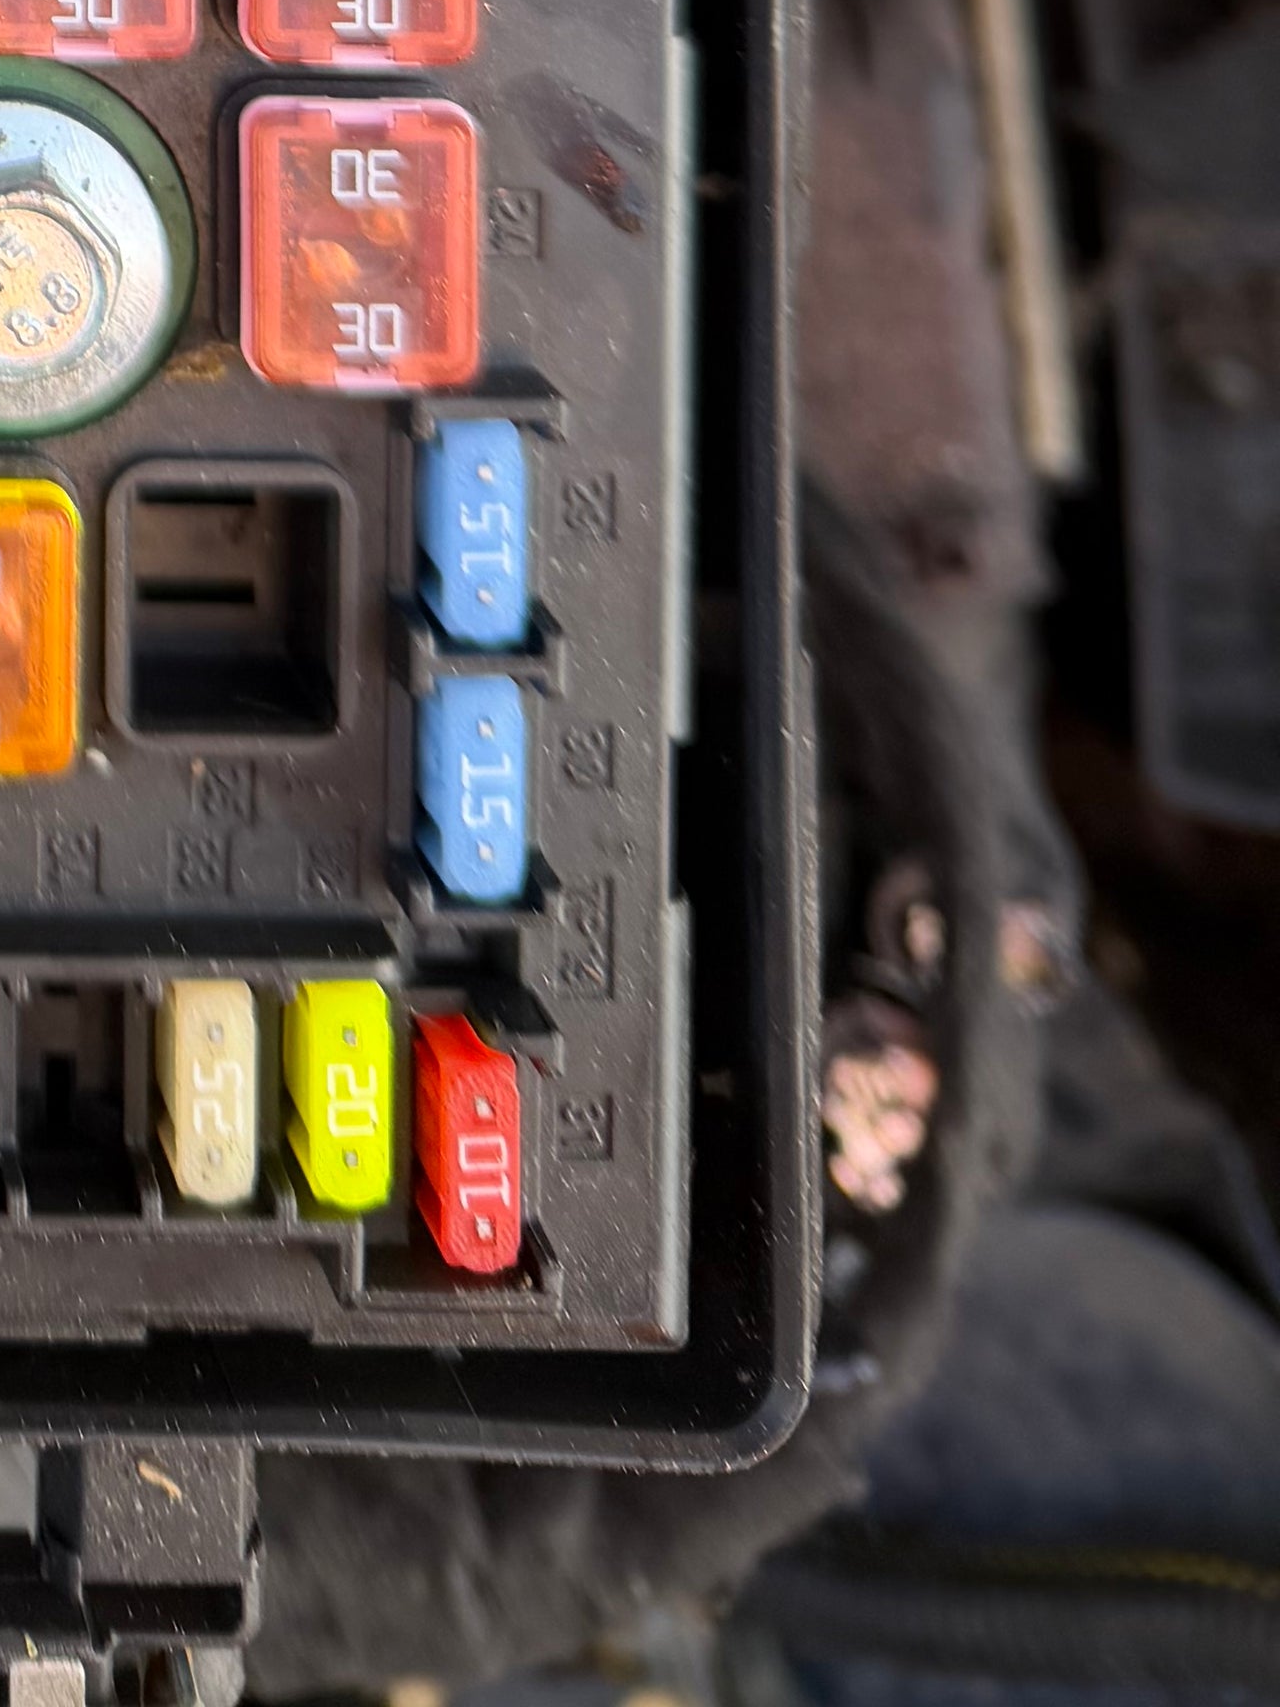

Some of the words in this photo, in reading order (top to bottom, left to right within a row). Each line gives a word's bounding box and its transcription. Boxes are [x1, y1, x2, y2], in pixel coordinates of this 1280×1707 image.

[330, 149, 402, 199] 30
[331, 303, 403, 357] 30
[461, 500, 512, 575] 15
[462, 755, 512, 830] 15
[192, 1061, 244, 1134] 25
[327, 1061, 378, 1138] 20
[458, 1134, 510, 1206] 10
